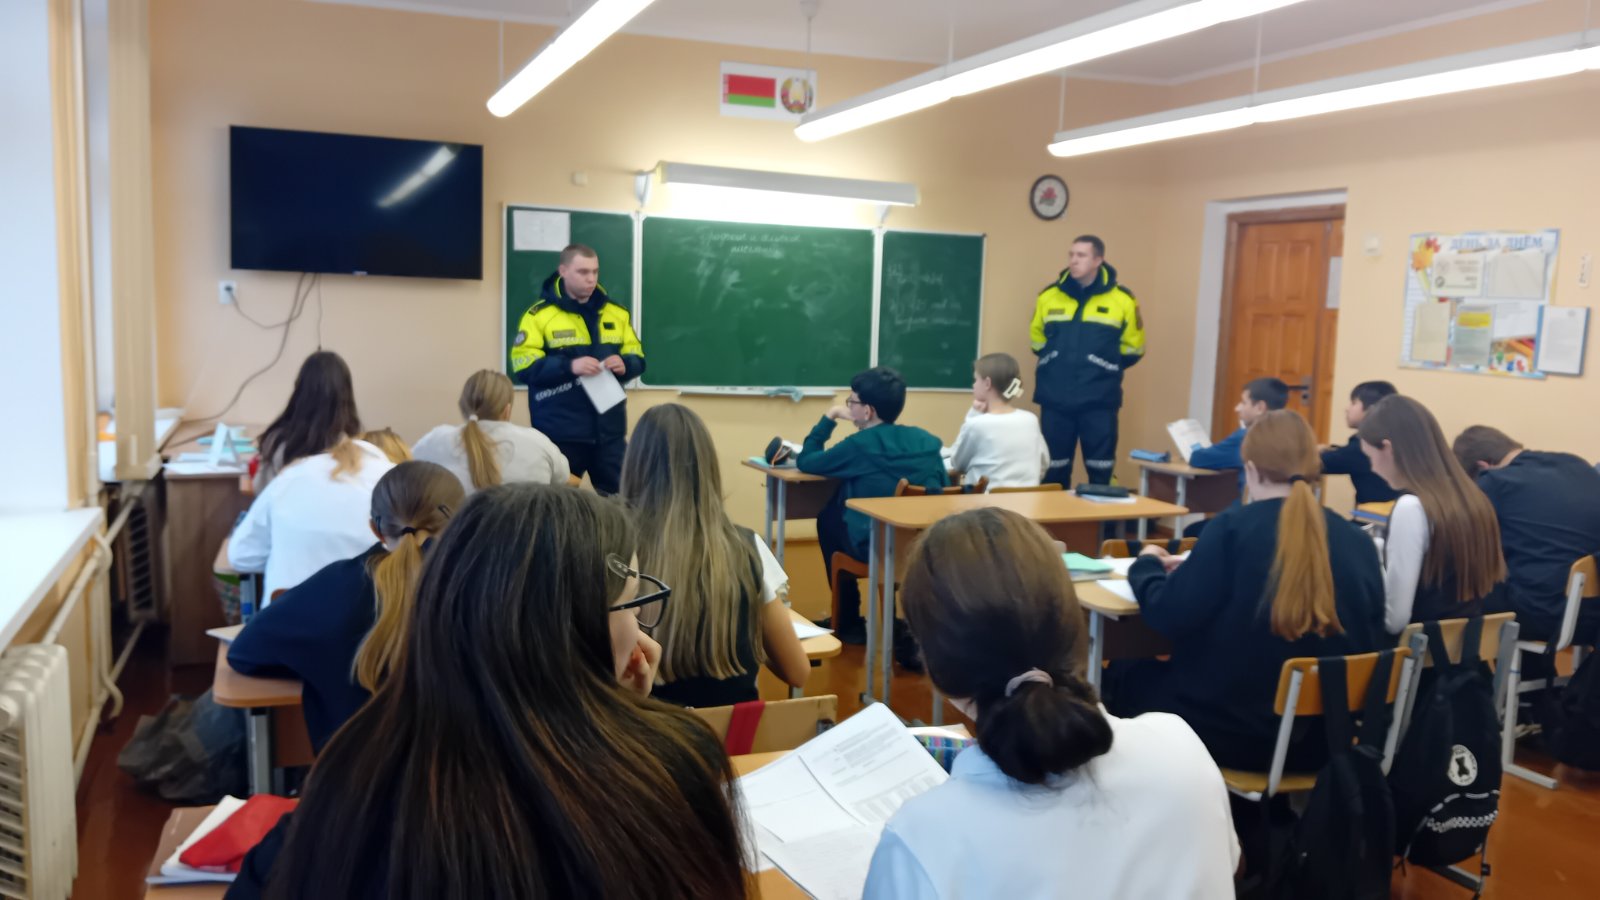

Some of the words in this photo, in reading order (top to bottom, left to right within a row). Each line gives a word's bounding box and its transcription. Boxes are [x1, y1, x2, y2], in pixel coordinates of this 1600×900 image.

[1450, 238, 1482, 250] ДЕНЬ
[1487, 237, 1500, 249] ЗА
[1506, 236, 1543, 249] ДНЁМ
